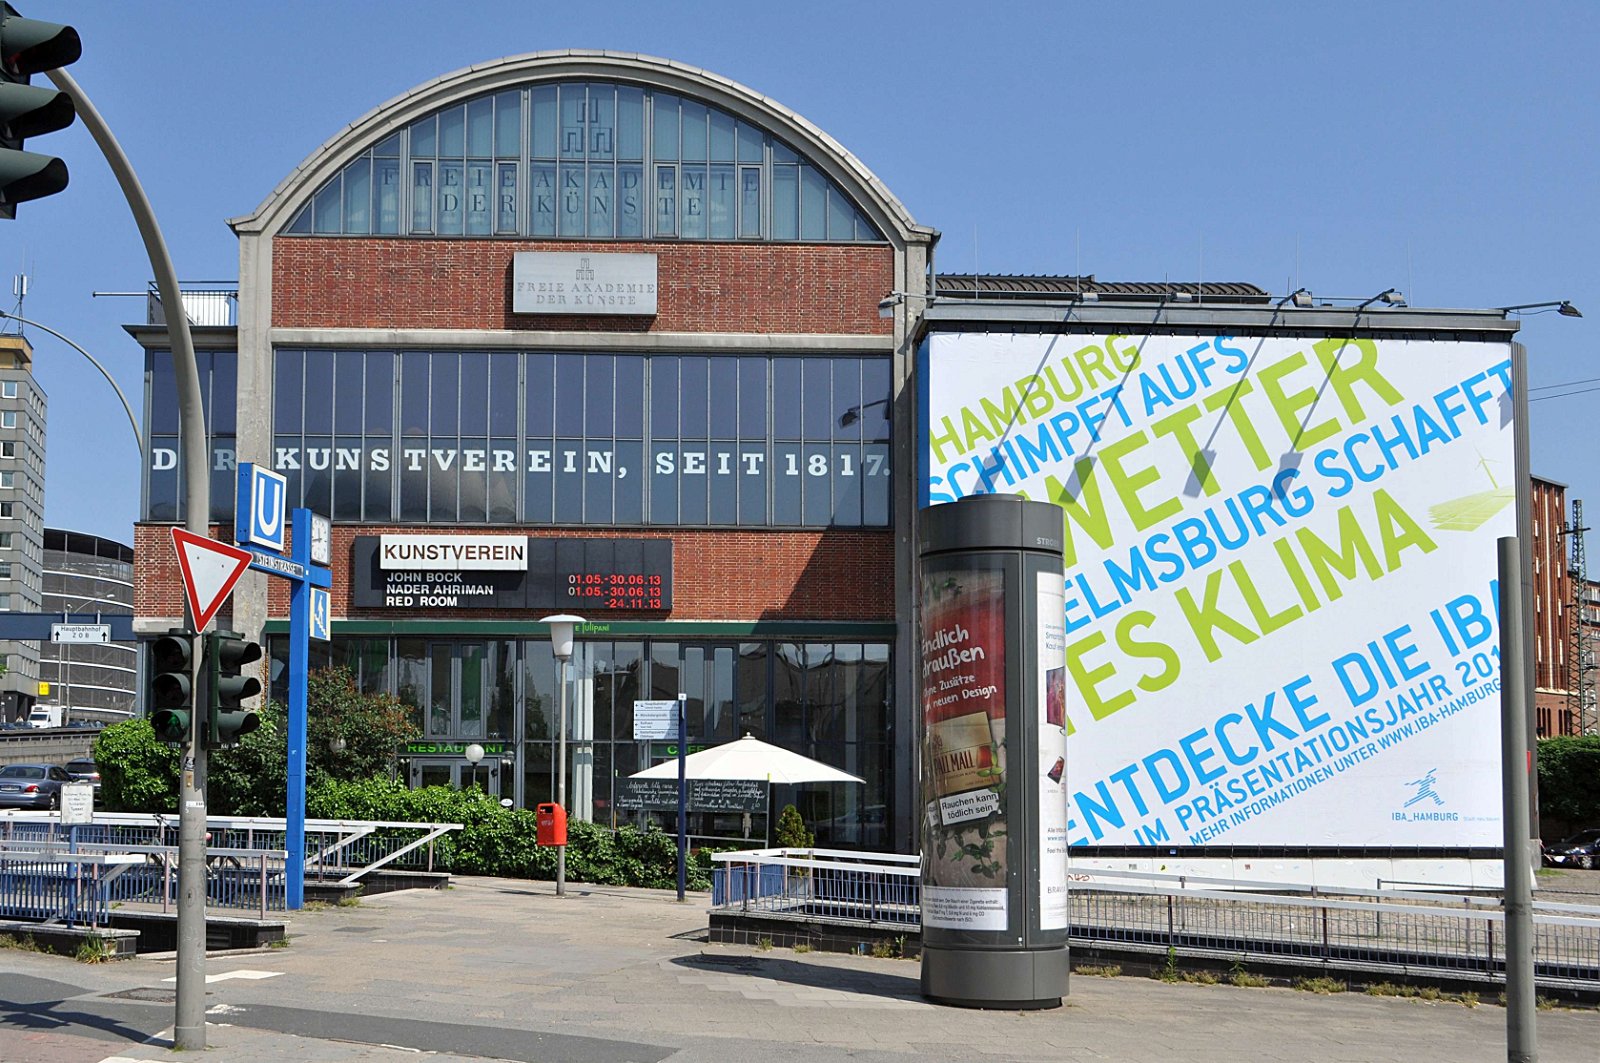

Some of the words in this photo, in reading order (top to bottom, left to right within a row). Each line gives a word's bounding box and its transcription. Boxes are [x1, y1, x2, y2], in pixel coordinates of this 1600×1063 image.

[383, 167, 516, 188] FREIE
[536, 169, 759, 193] AKADEMIE
[443, 193, 517, 213] DER
[538, 190, 702, 217] KÜNSTE
[517, 282, 565, 293] FREIE
[571, 283, 656, 294] AKADEMIE
[536, 294, 567, 305] DER
[574, 293, 637, 306] KÜNSTE
[930, 333, 1143, 465] HAMBURG
[930, 384, 1134, 505] SCHIMPFT
[1138, 335, 1249, 416] AUFS
[1314, 359, 1513, 498] SCHAFFT
[152, 448, 236, 471] DR
[275, 448, 628, 479] KUNSTVEREIN,
[655, 452, 765, 475] SEIT
[785, 453, 891, 477] 1817.
[1016, 337, 1405, 569] WETTER
[384, 544, 524, 561] KUNSTVEREIN
[387, 572, 422, 583] JOHN
[426, 572, 463, 583] BOCK
[386, 583, 430, 595] NADER
[433, 584, 494, 596] AHRIMAN
[386, 595, 413, 607] RED
[419, 595, 458, 607] ROOM
[604, 597, 661, 609] -24.11.13
[1066, 610, 1182, 736] ES
[1173, 488, 1438, 664] KLIMA
[922, 646, 985, 679] draußen
[1330, 624, 1432, 708] DIE
[939, 674, 976, 691] Zusätze
[933, 693, 959, 709] neuen
[961, 685, 997, 700] Design
[407, 743, 504, 753] RESTAUNT
[951, 750, 975, 771] MALL
[1133, 818, 1171, 847] IM
[1174, 674, 1454, 832] PRÄSENTATIONSJAHR
[941, 797, 975, 811] Rauchen
[975, 793, 998, 803] kann
[1189, 818, 1231, 846] MEHR
[1229, 765, 1334, 826] INFORMATIONEN
[1333, 743, 1379, 773] UNTER
[947, 806, 974, 819] tödlich
[975, 804, 993, 813] sein
[1391, 812, 1459, 823] IBA_HAMBURG
